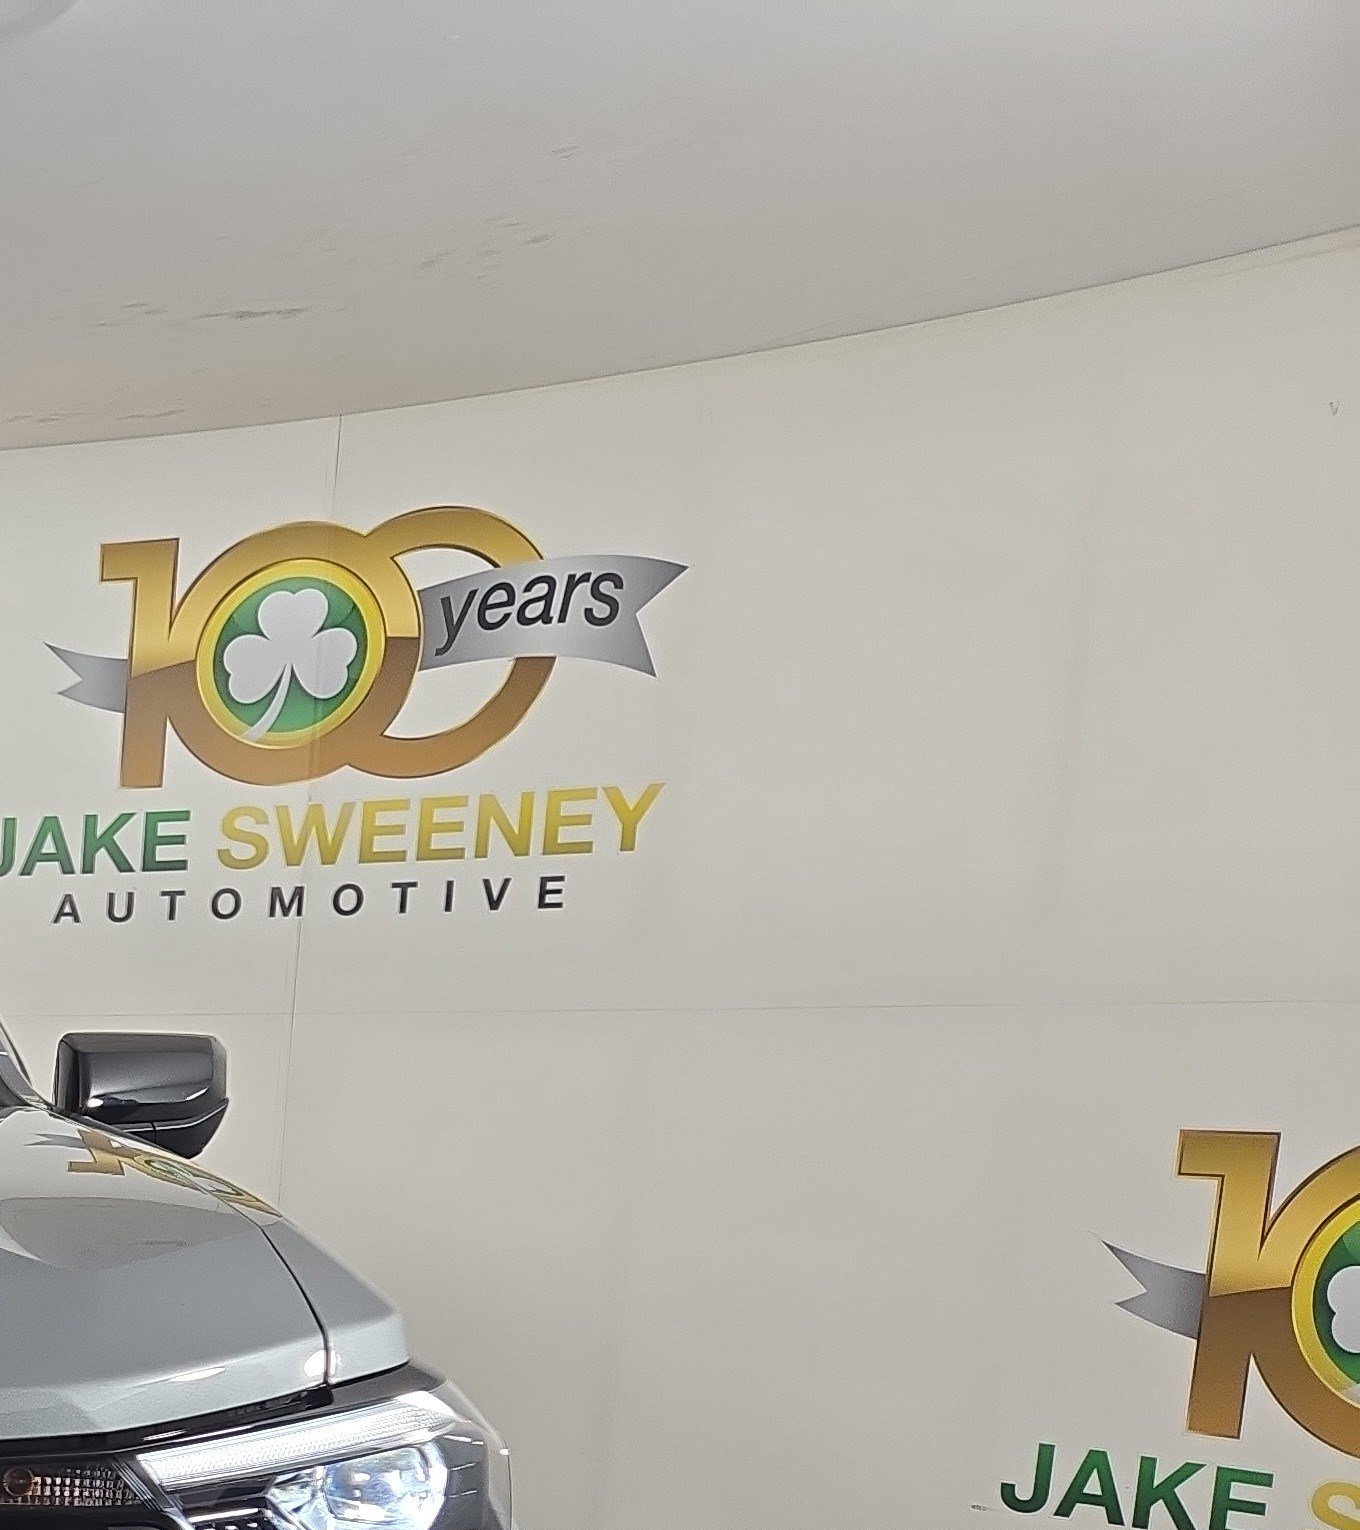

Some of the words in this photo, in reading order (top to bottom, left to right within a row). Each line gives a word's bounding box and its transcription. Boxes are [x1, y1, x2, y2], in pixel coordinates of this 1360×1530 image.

[434, 569, 625, 656] years
[216, 782, 666, 871] SWEENEY
[52, 875, 567, 925] AUTOMOTIVE
